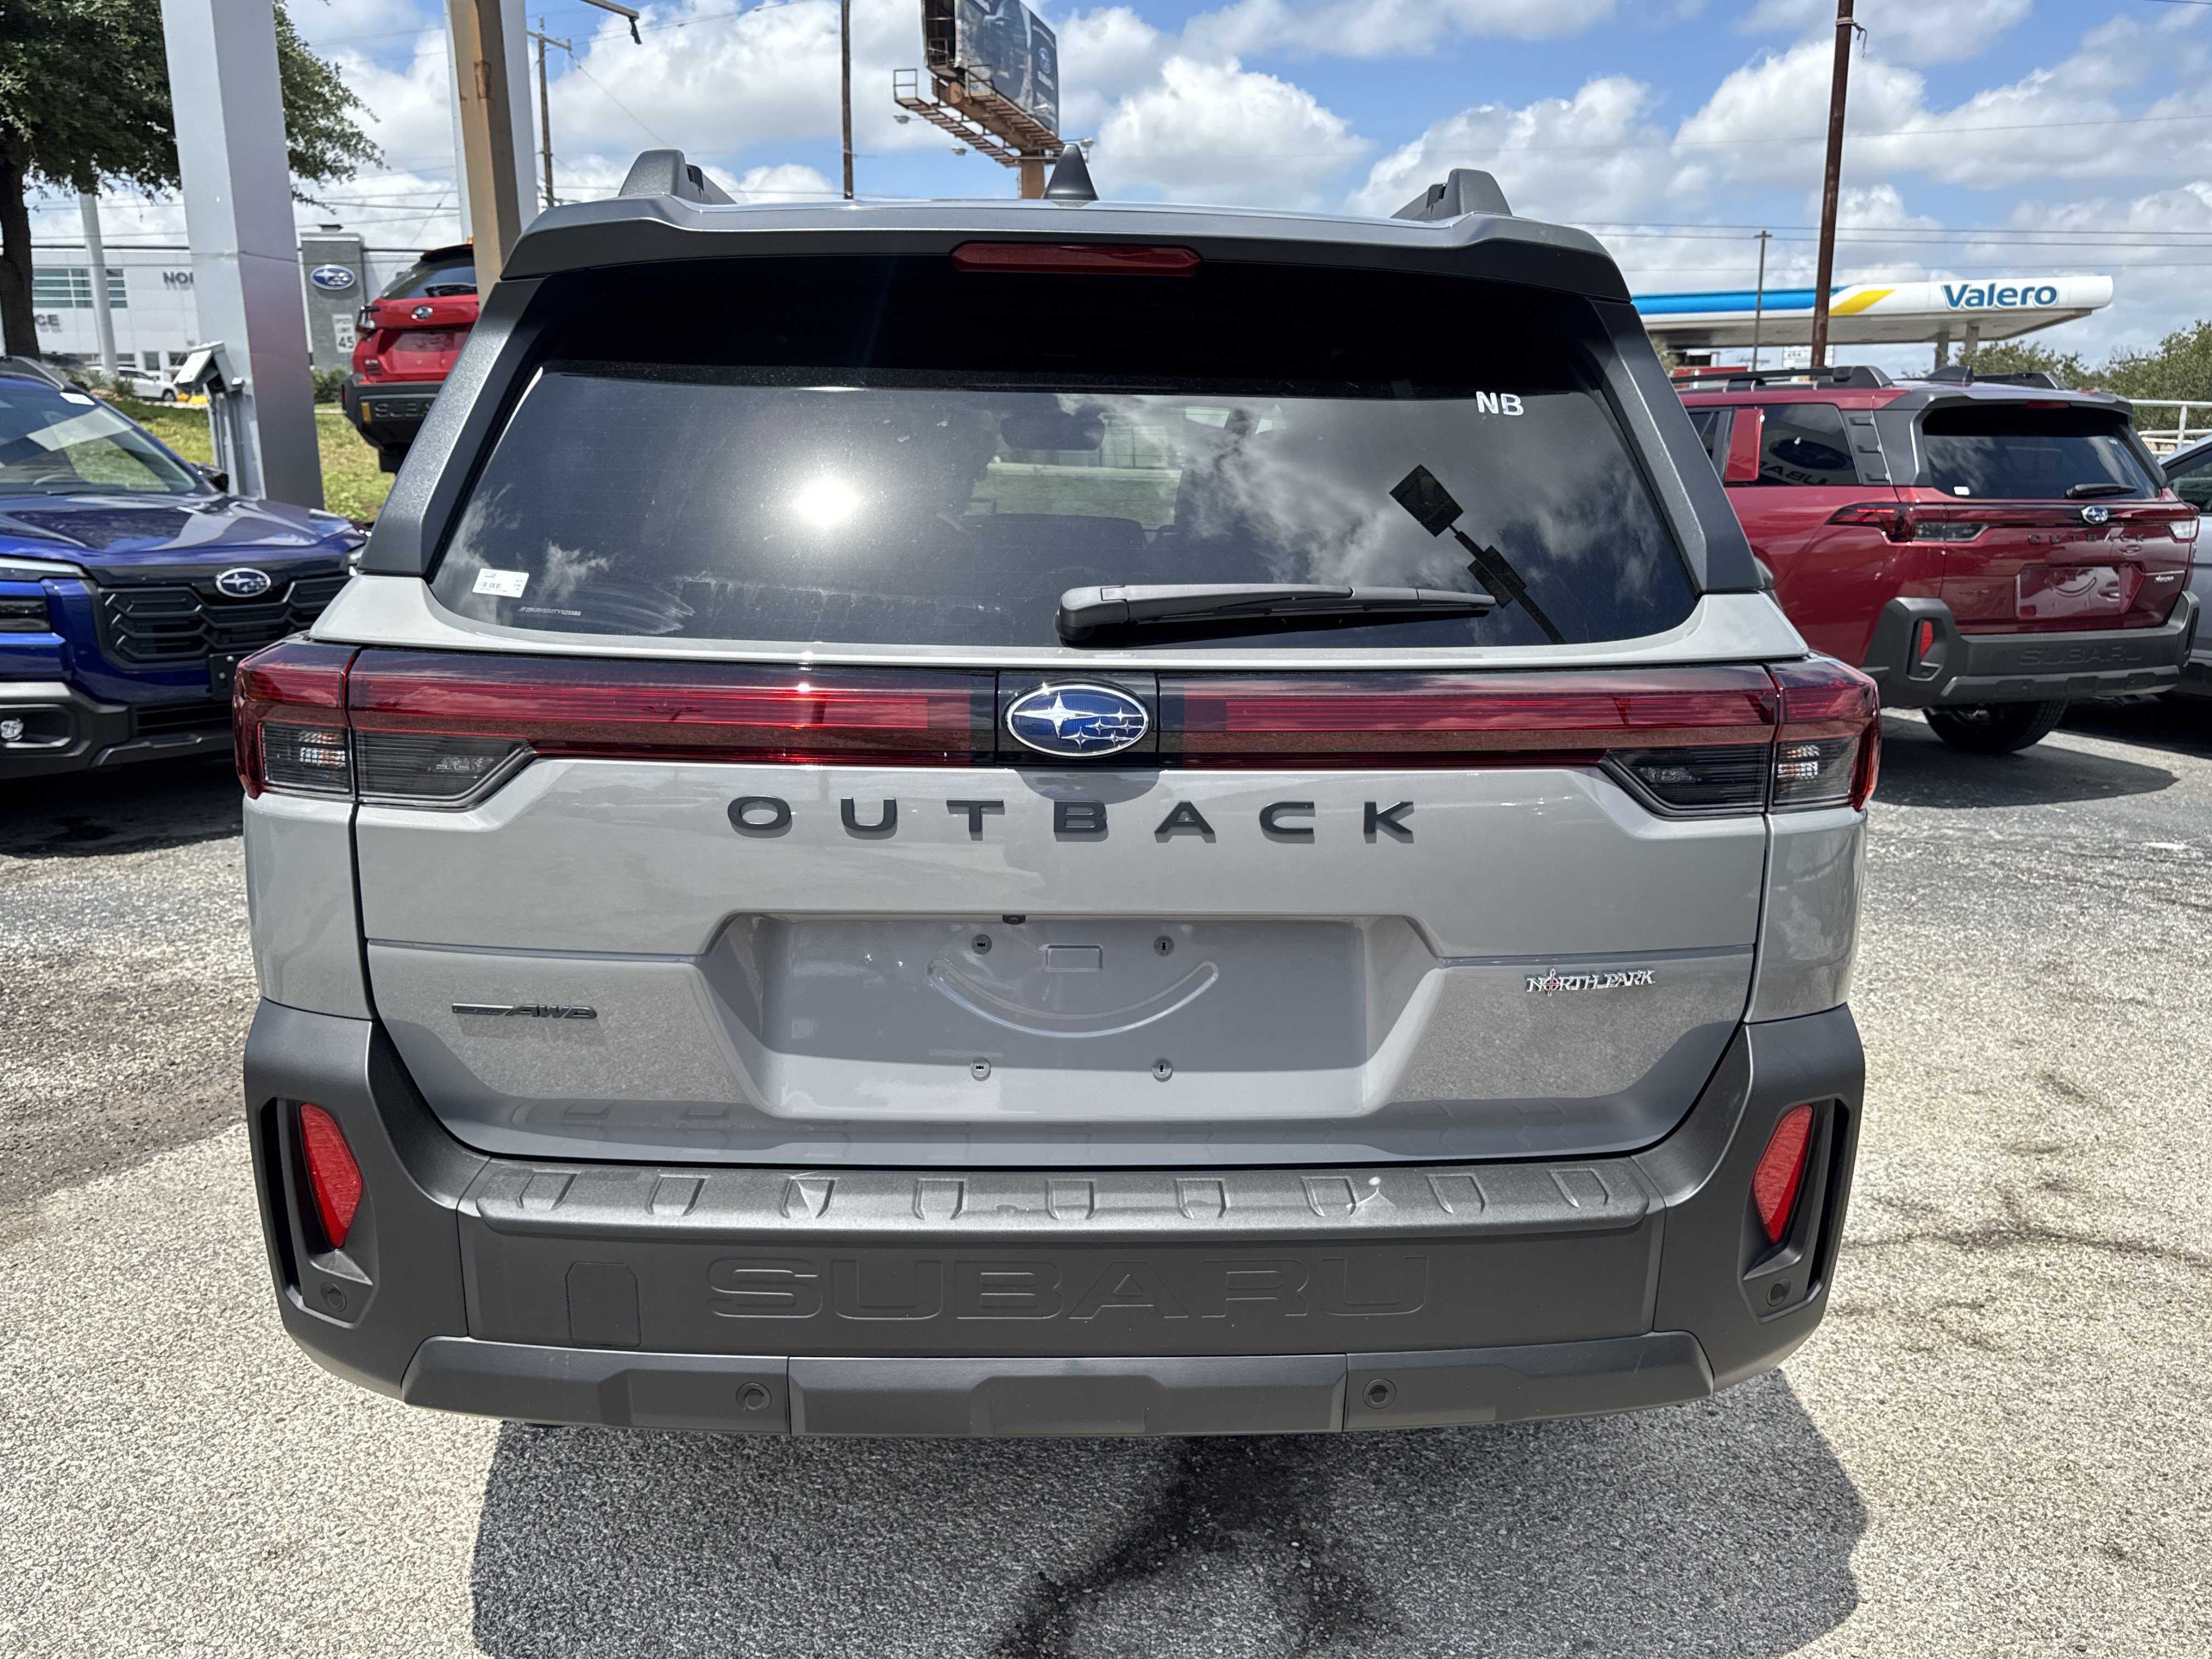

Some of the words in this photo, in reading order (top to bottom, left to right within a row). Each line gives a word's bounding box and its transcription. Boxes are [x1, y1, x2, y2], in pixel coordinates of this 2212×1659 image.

[1943, 283, 2057, 308] Valero
[34, 314, 59, 326] CE
[338, 336, 354, 349] 45
[375, 402, 432, 417] SUBA
[1476, 391, 1523, 415] NB
[2028, 533, 2145, 545] OUTBACK
[2018, 646, 2143, 665] SUBARU
[727, 795, 1414, 834] OUTBACK
[504, 1003, 597, 1019] AWD
[706, 1256, 1429, 1320] SUBARU
